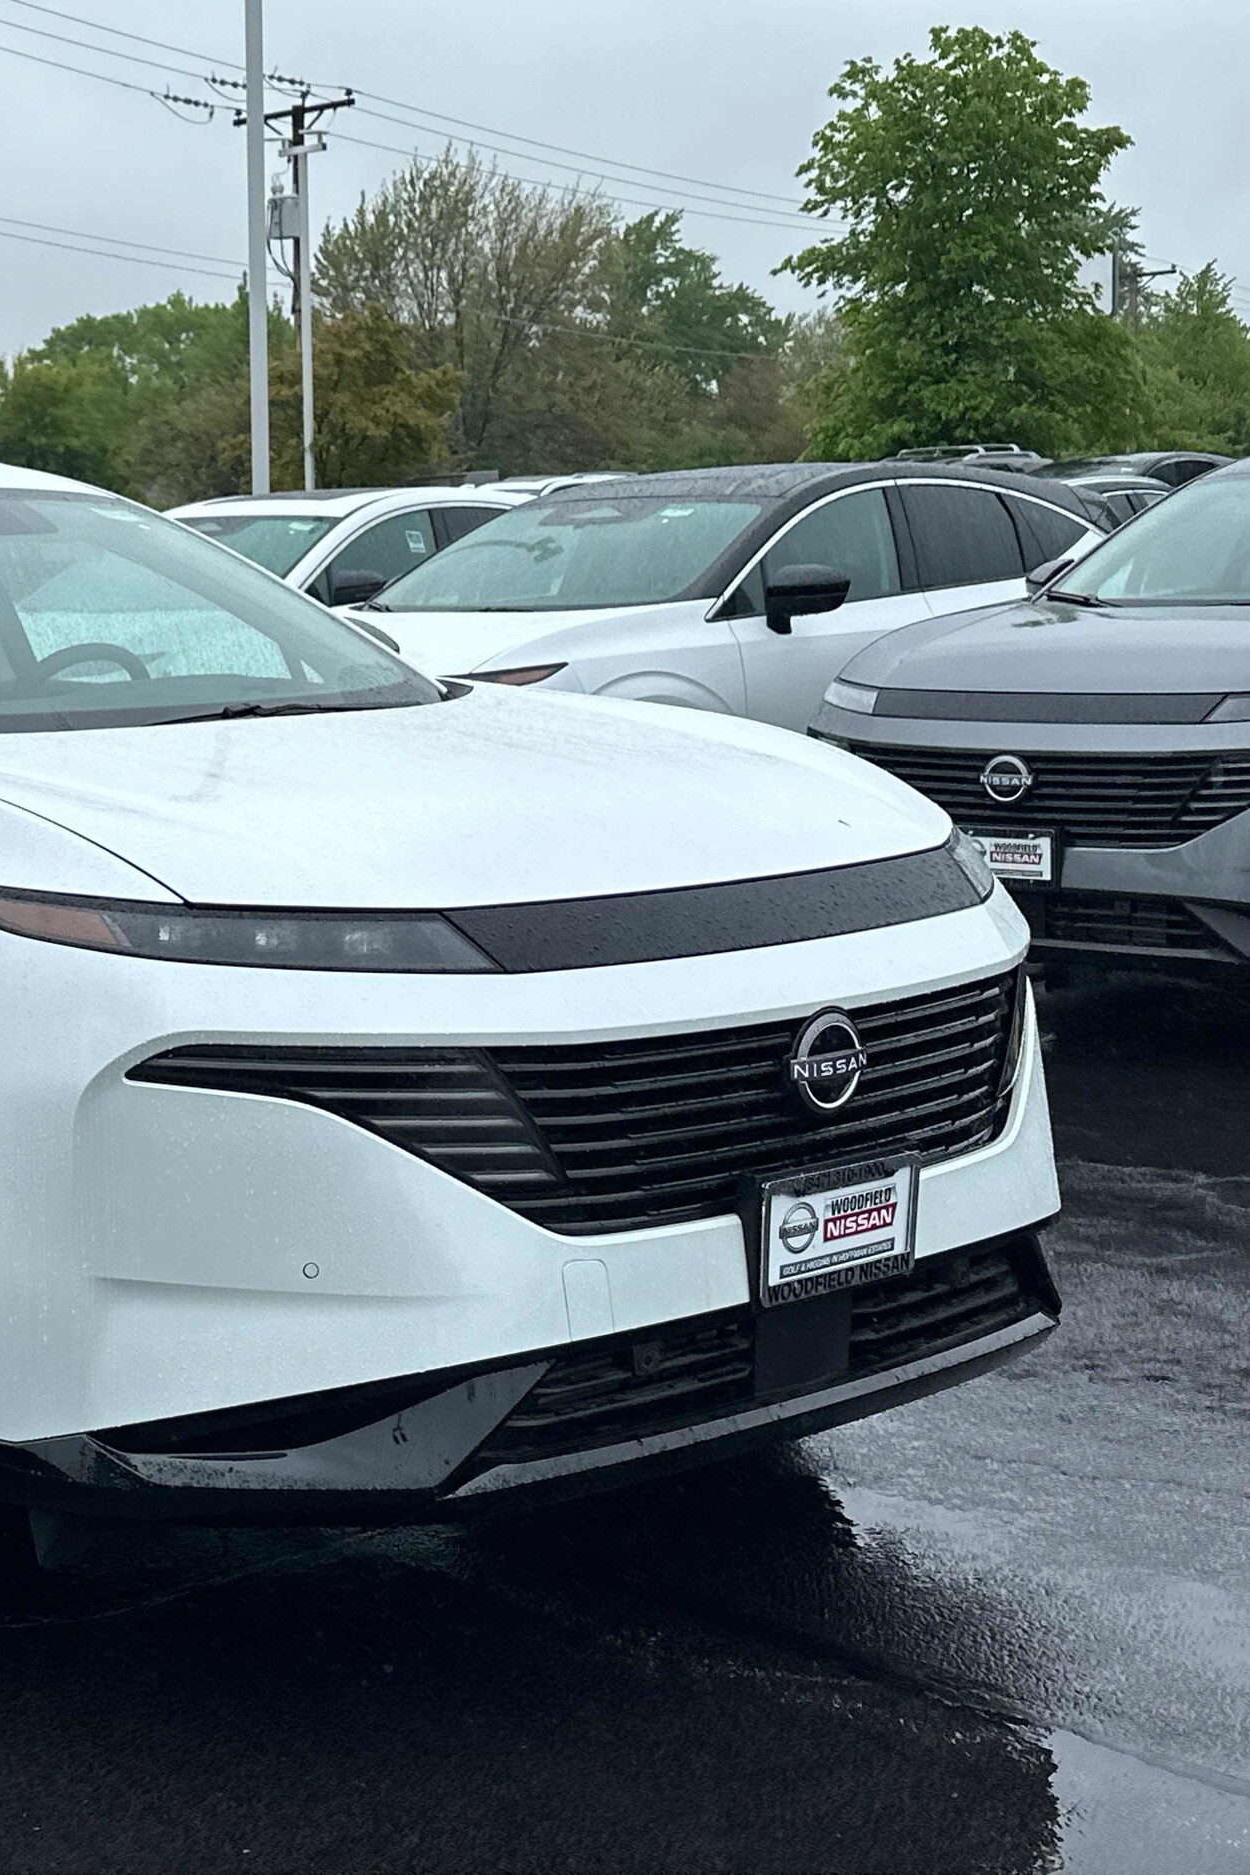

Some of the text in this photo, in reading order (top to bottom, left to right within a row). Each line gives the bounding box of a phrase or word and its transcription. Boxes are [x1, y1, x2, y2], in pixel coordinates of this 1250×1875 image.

[979, 774, 1032, 786] NISSAN
[991, 852, 1040, 864] NISSAN
[793, 1053, 867, 1079] NISSAN
[831, 1187, 892, 1216] WOODFIELD
[781, 1220, 817, 1237] NISSAN
[826, 1207, 893, 1238] NISSAN
[767, 1251, 911, 1303] WOODFIELD NISSAN
